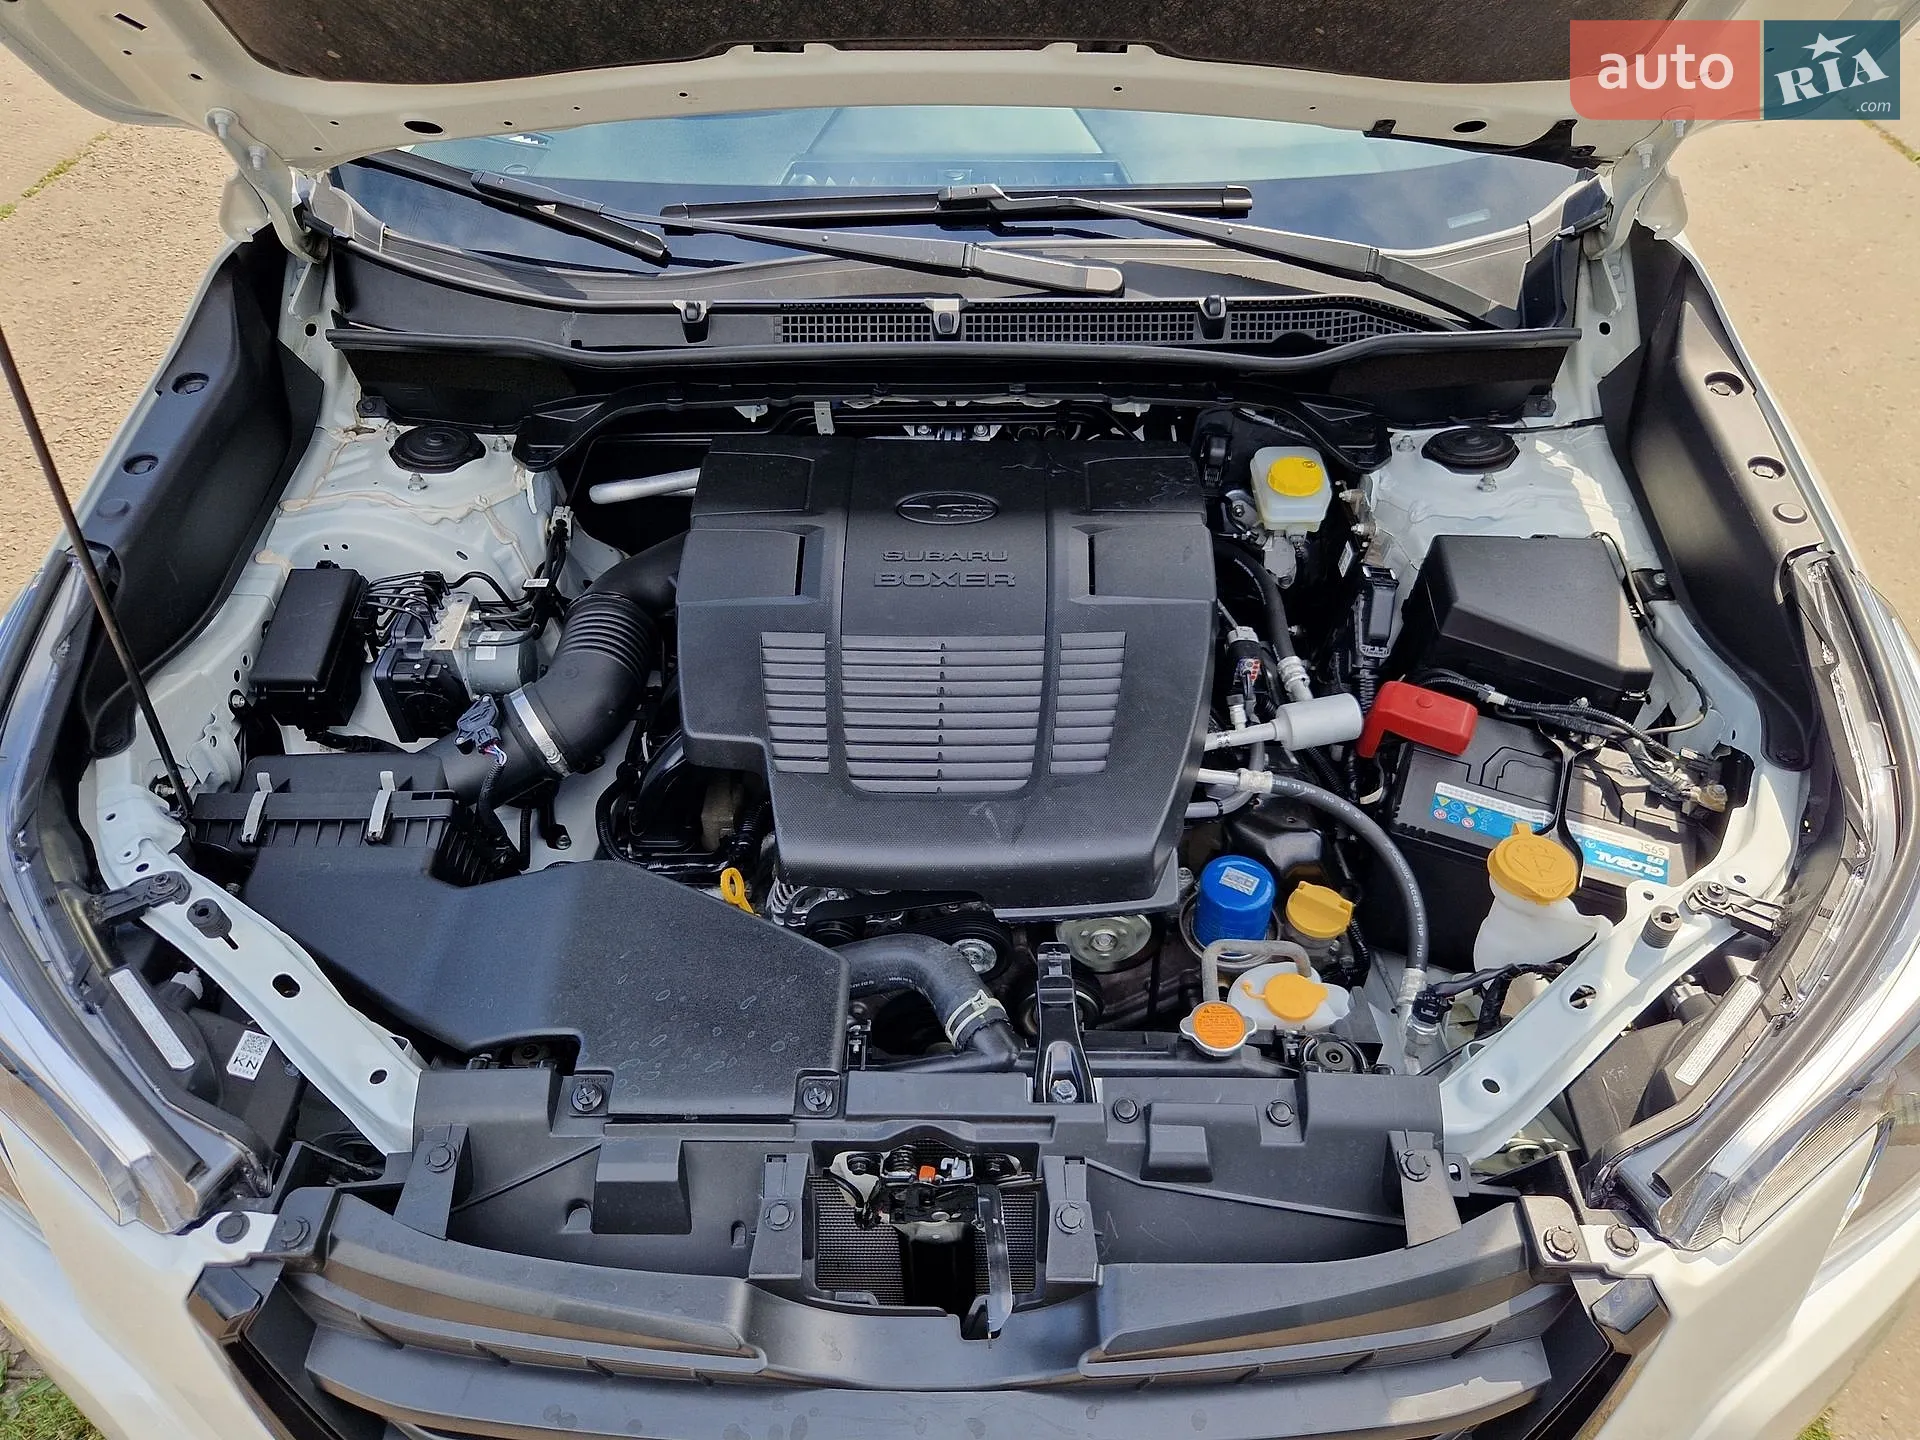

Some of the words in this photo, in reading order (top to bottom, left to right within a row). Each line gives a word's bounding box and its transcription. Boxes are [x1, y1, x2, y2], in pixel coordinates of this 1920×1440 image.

[882, 550, 1009, 562] SUBARU
[874, 571, 1016, 588] BOXER
[1595, 849, 1665, 877] GLOBAL
[1646, 855, 1665, 866] EFB
[233, 1056, 259, 1070] KN
